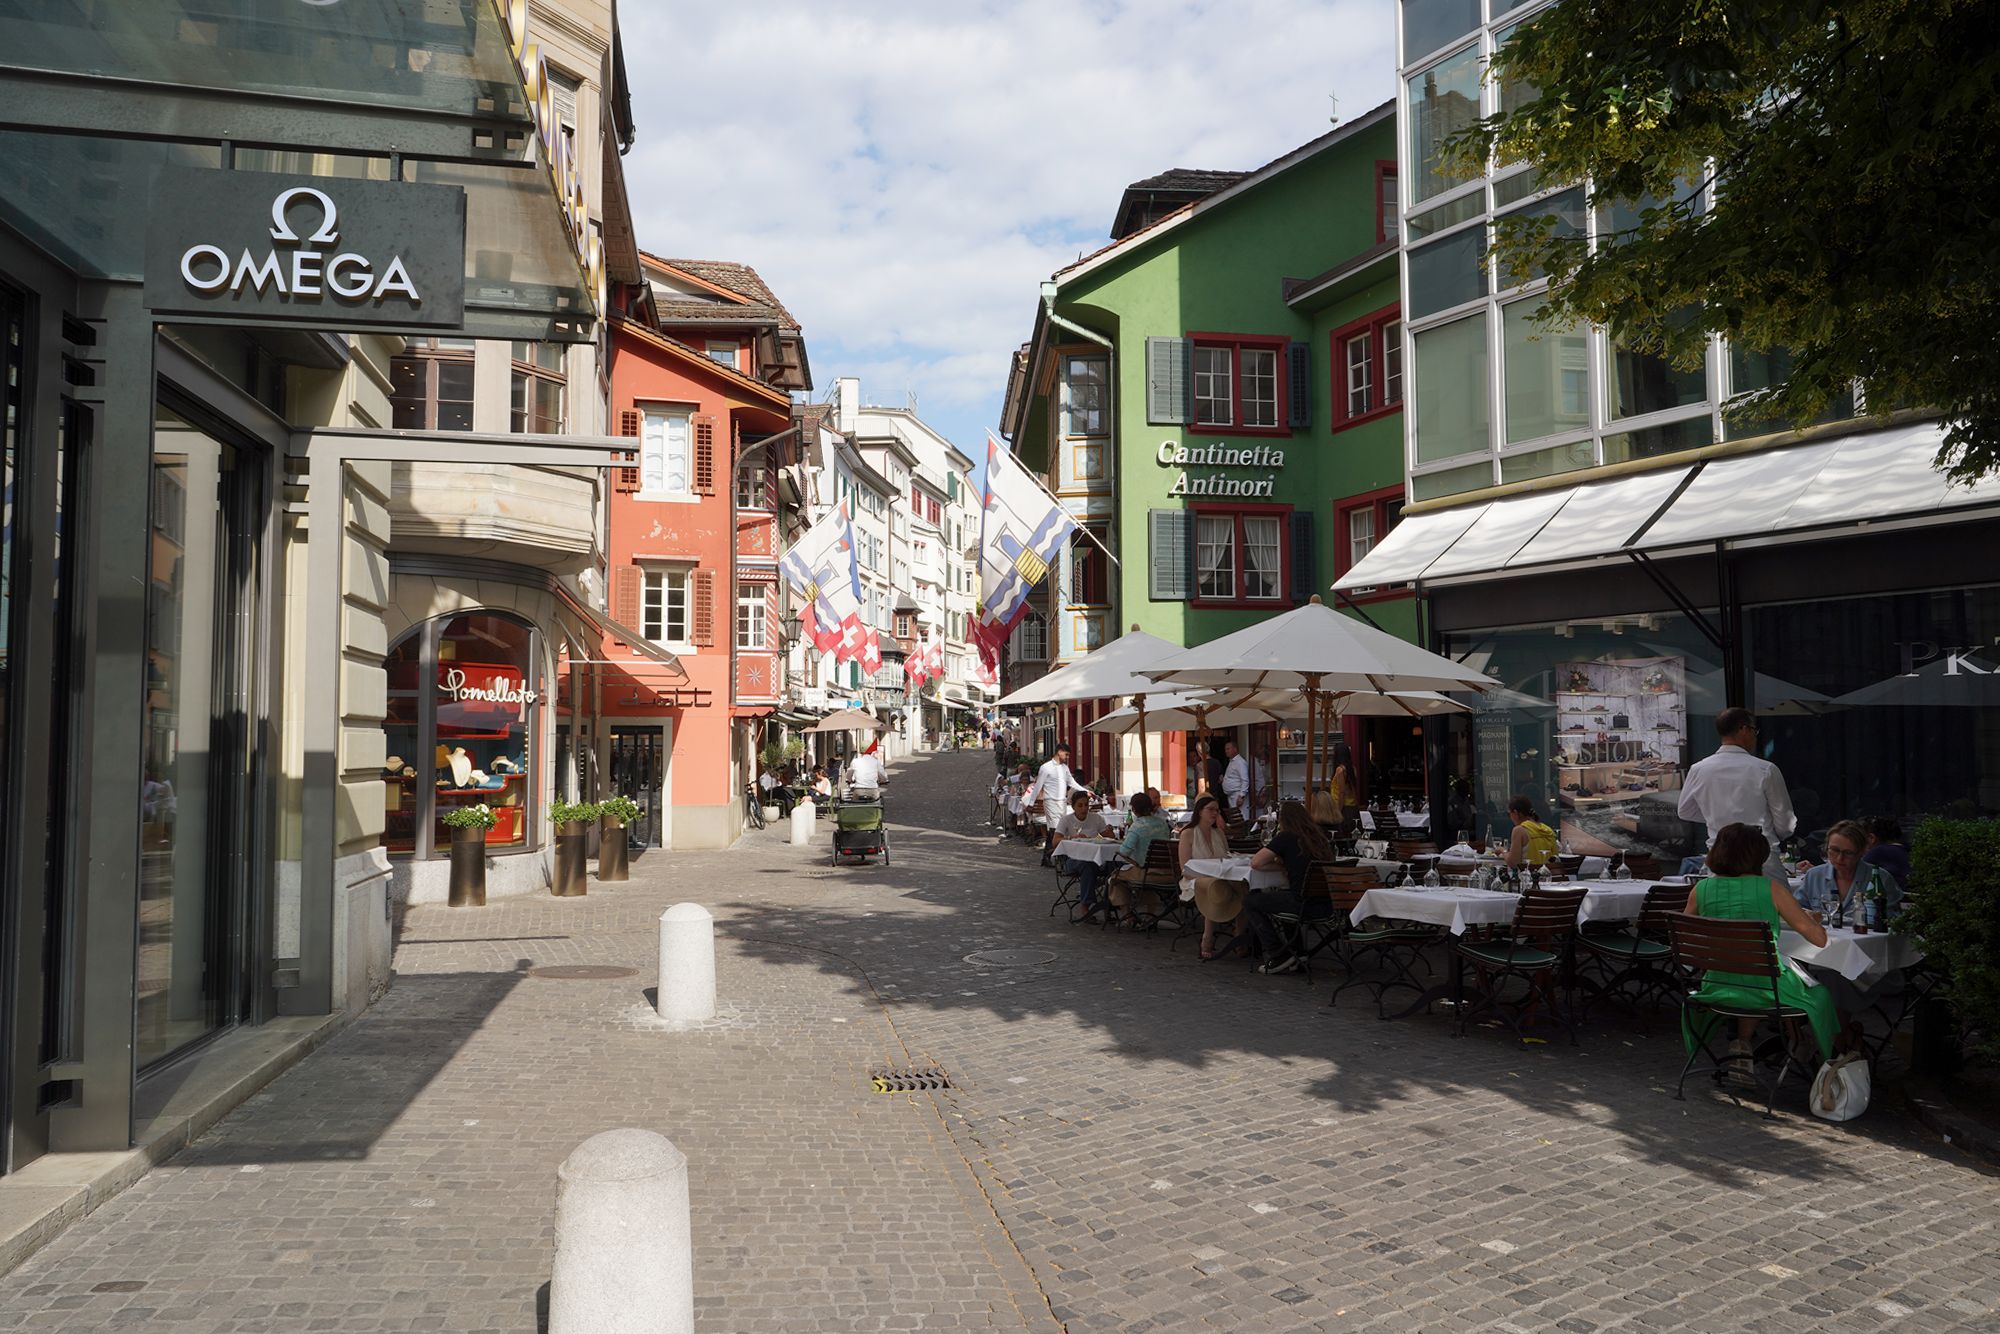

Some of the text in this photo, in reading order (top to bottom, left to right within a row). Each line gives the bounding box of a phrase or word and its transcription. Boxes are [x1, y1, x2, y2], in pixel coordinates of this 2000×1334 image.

[181, 244, 420, 299] OMEGA
[1157, 440, 1285, 466] Cantinetta
[1168, 471, 1275, 496] Antinori
[438, 668, 538, 703] Pomellato
[1579, 740, 1663, 764] SHOES
